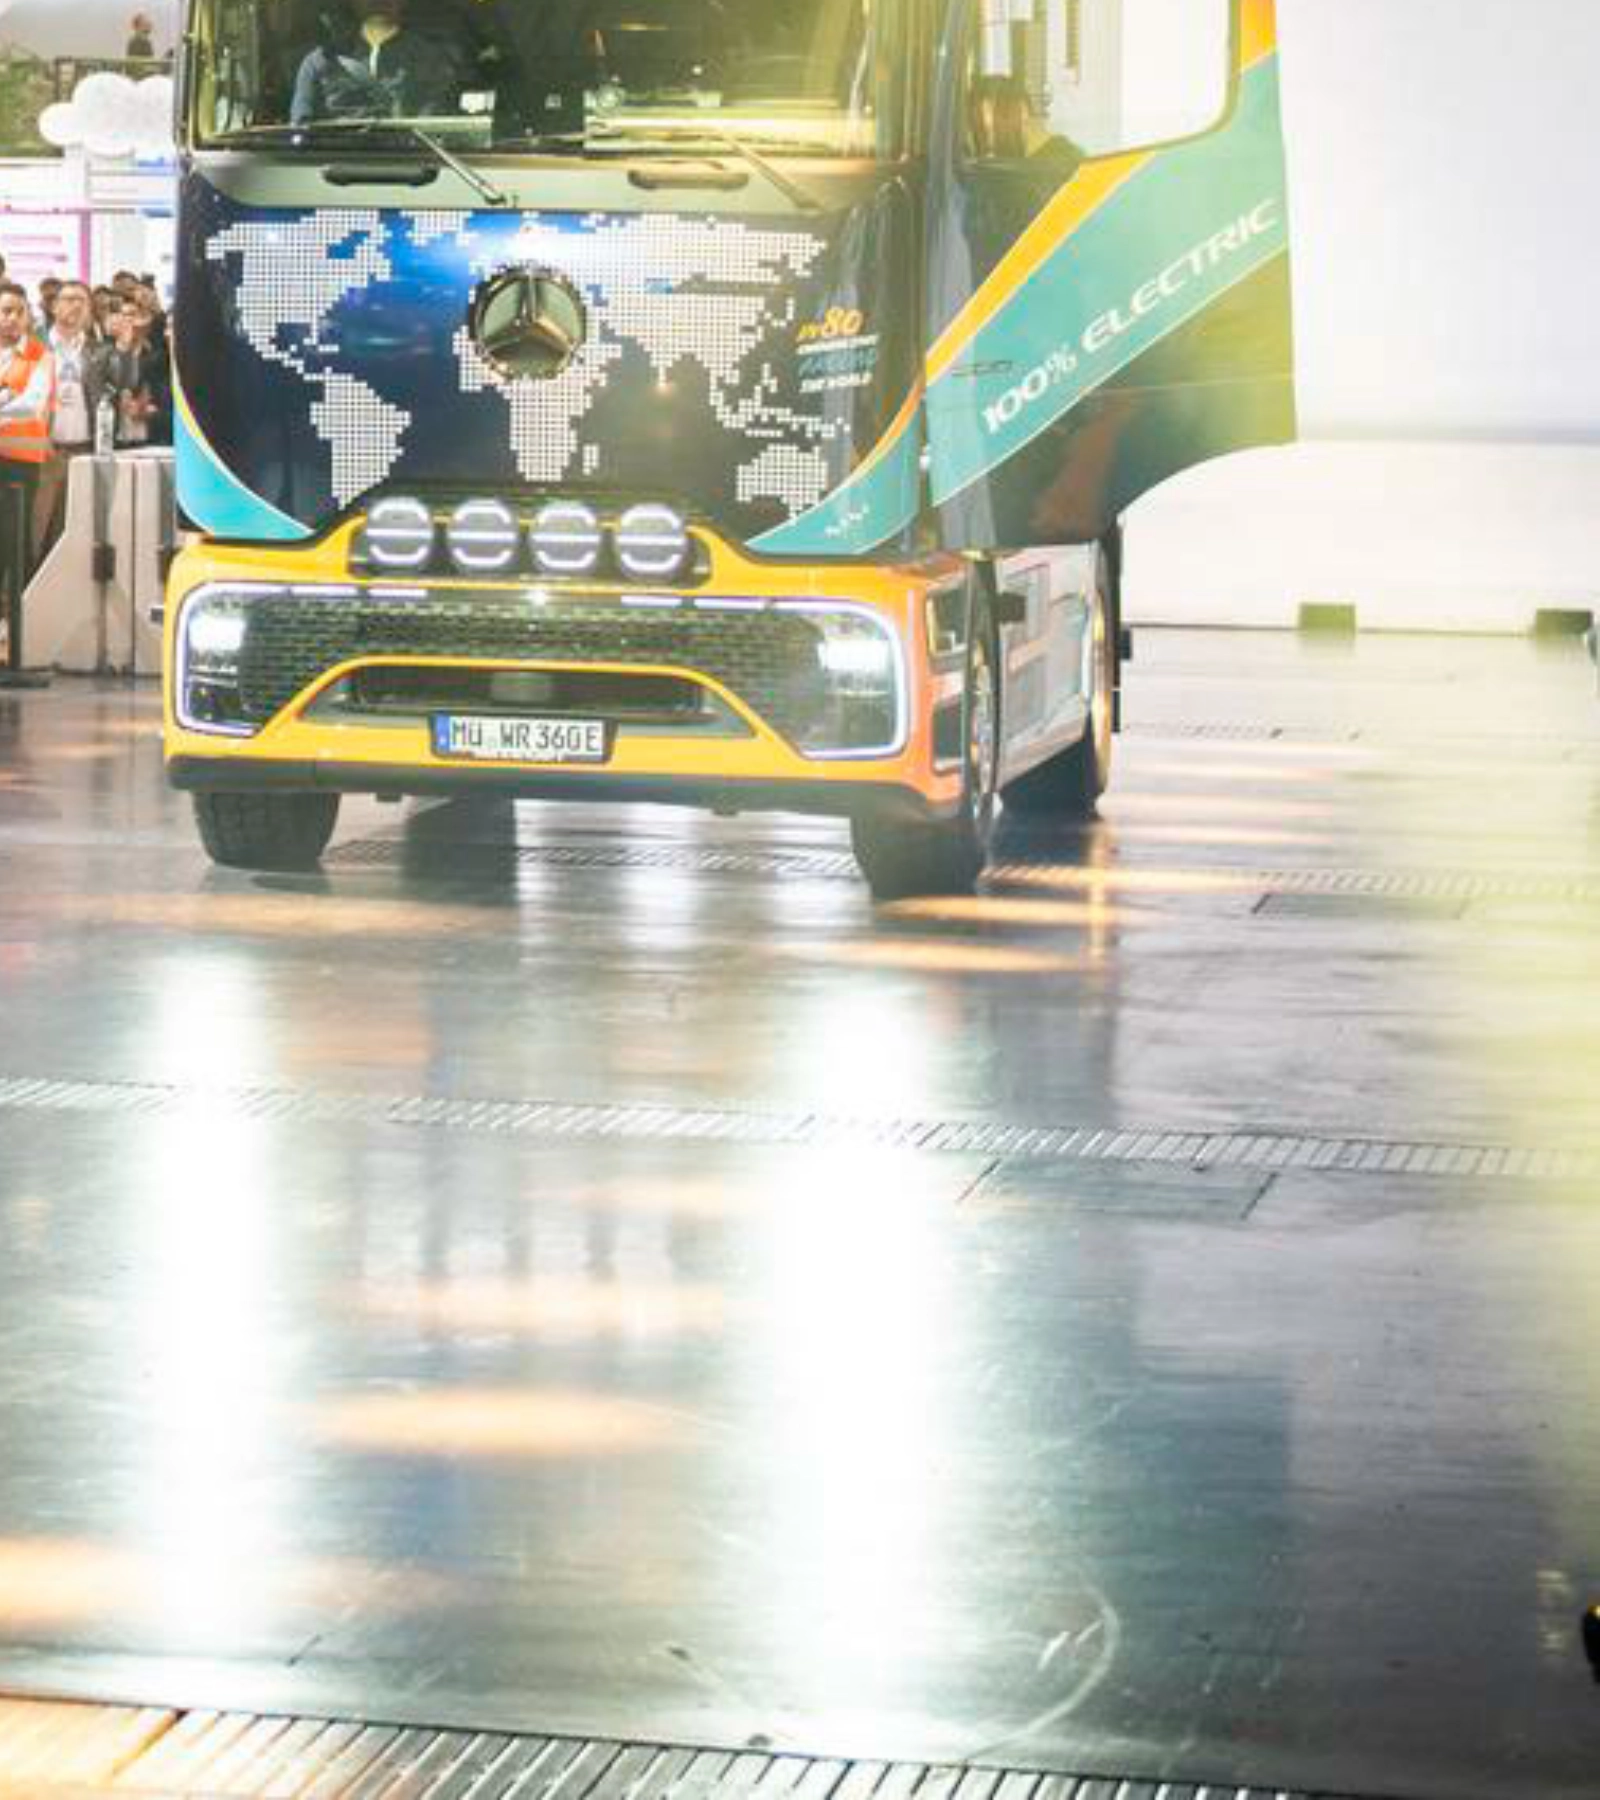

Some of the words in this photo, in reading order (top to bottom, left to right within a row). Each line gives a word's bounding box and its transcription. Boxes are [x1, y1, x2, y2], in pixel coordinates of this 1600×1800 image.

[821, 306, 864, 337] 80
[983, 343, 1078, 435] 100%
[1080, 199, 1277, 353] ELECTRIC
